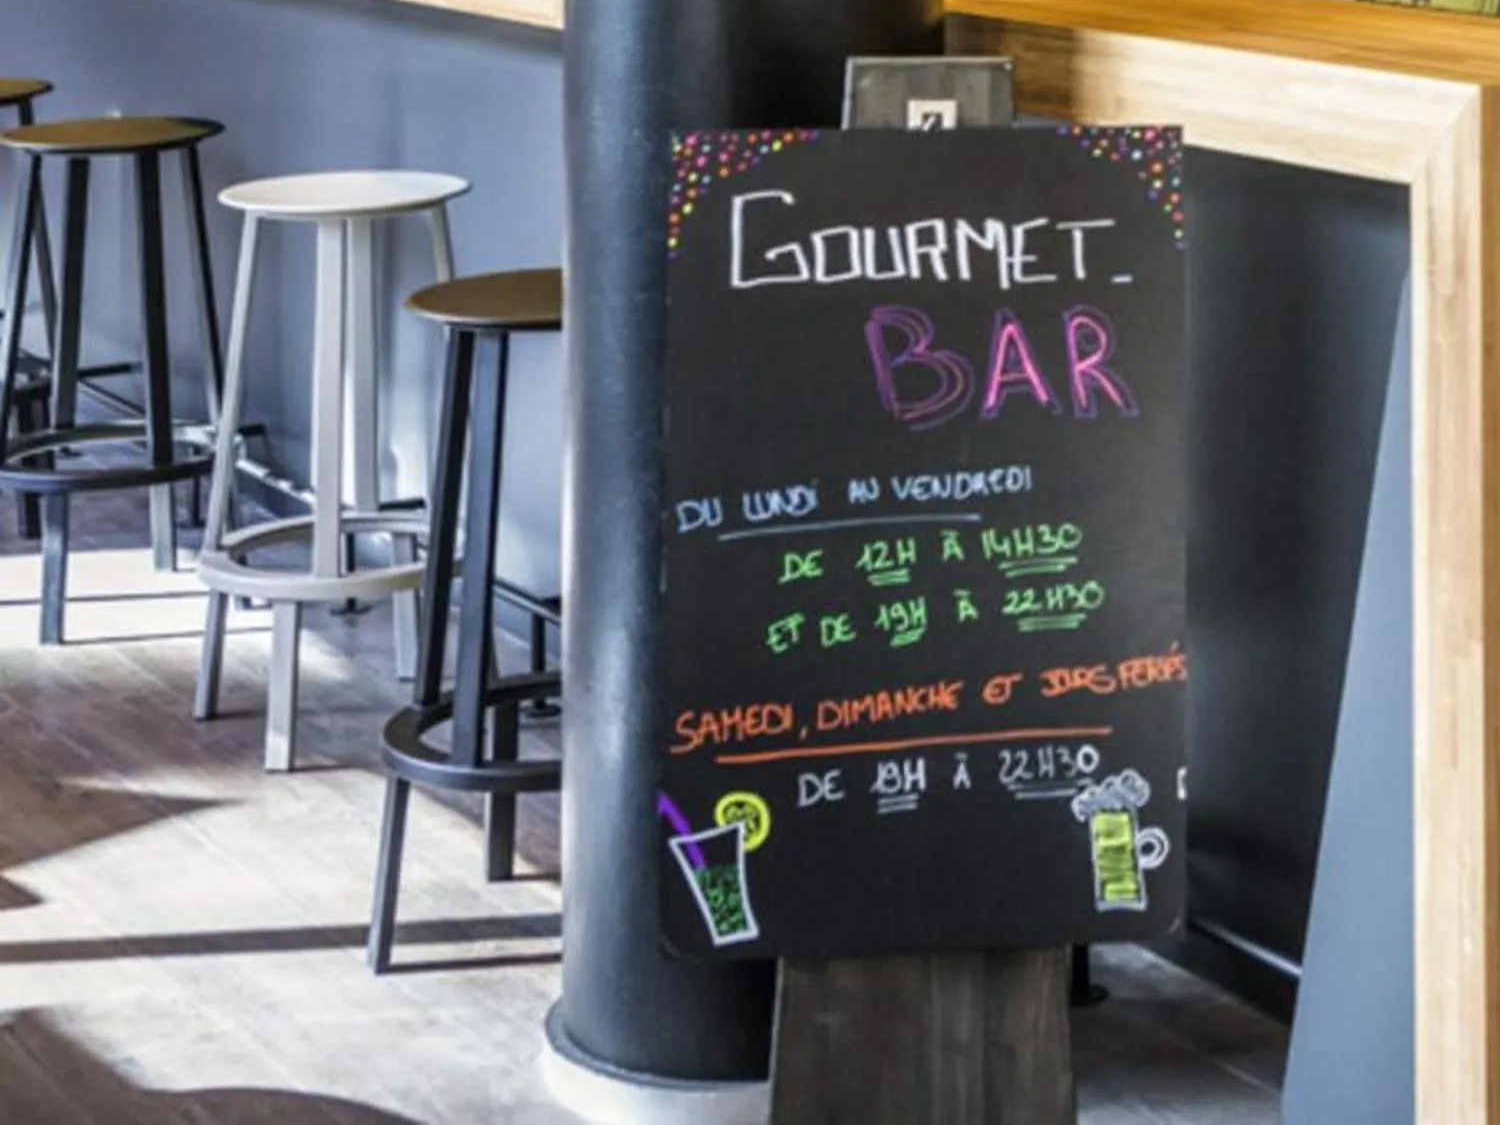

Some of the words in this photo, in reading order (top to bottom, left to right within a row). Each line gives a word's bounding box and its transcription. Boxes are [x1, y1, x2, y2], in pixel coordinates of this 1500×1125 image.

[863, 305, 1140, 432] BAR
[676, 496, 723, 533] DU
[848, 477, 880, 505] AU
[891, 466, 1033, 502] VENDREDI
[778, 549, 823, 584] DE
[856, 537, 917, 572] 12H
[982, 522, 1083, 559] 14H30
[766, 614, 806, 653] ET
[820, 615, 856, 646] DE
[874, 597, 926, 633] 19H
[1002, 581, 1105, 616] 22H30
[816, 680, 964, 731] DIMANCHE
[798, 769, 846, 806] DE
[999, 743, 1099, 784] 22H30
